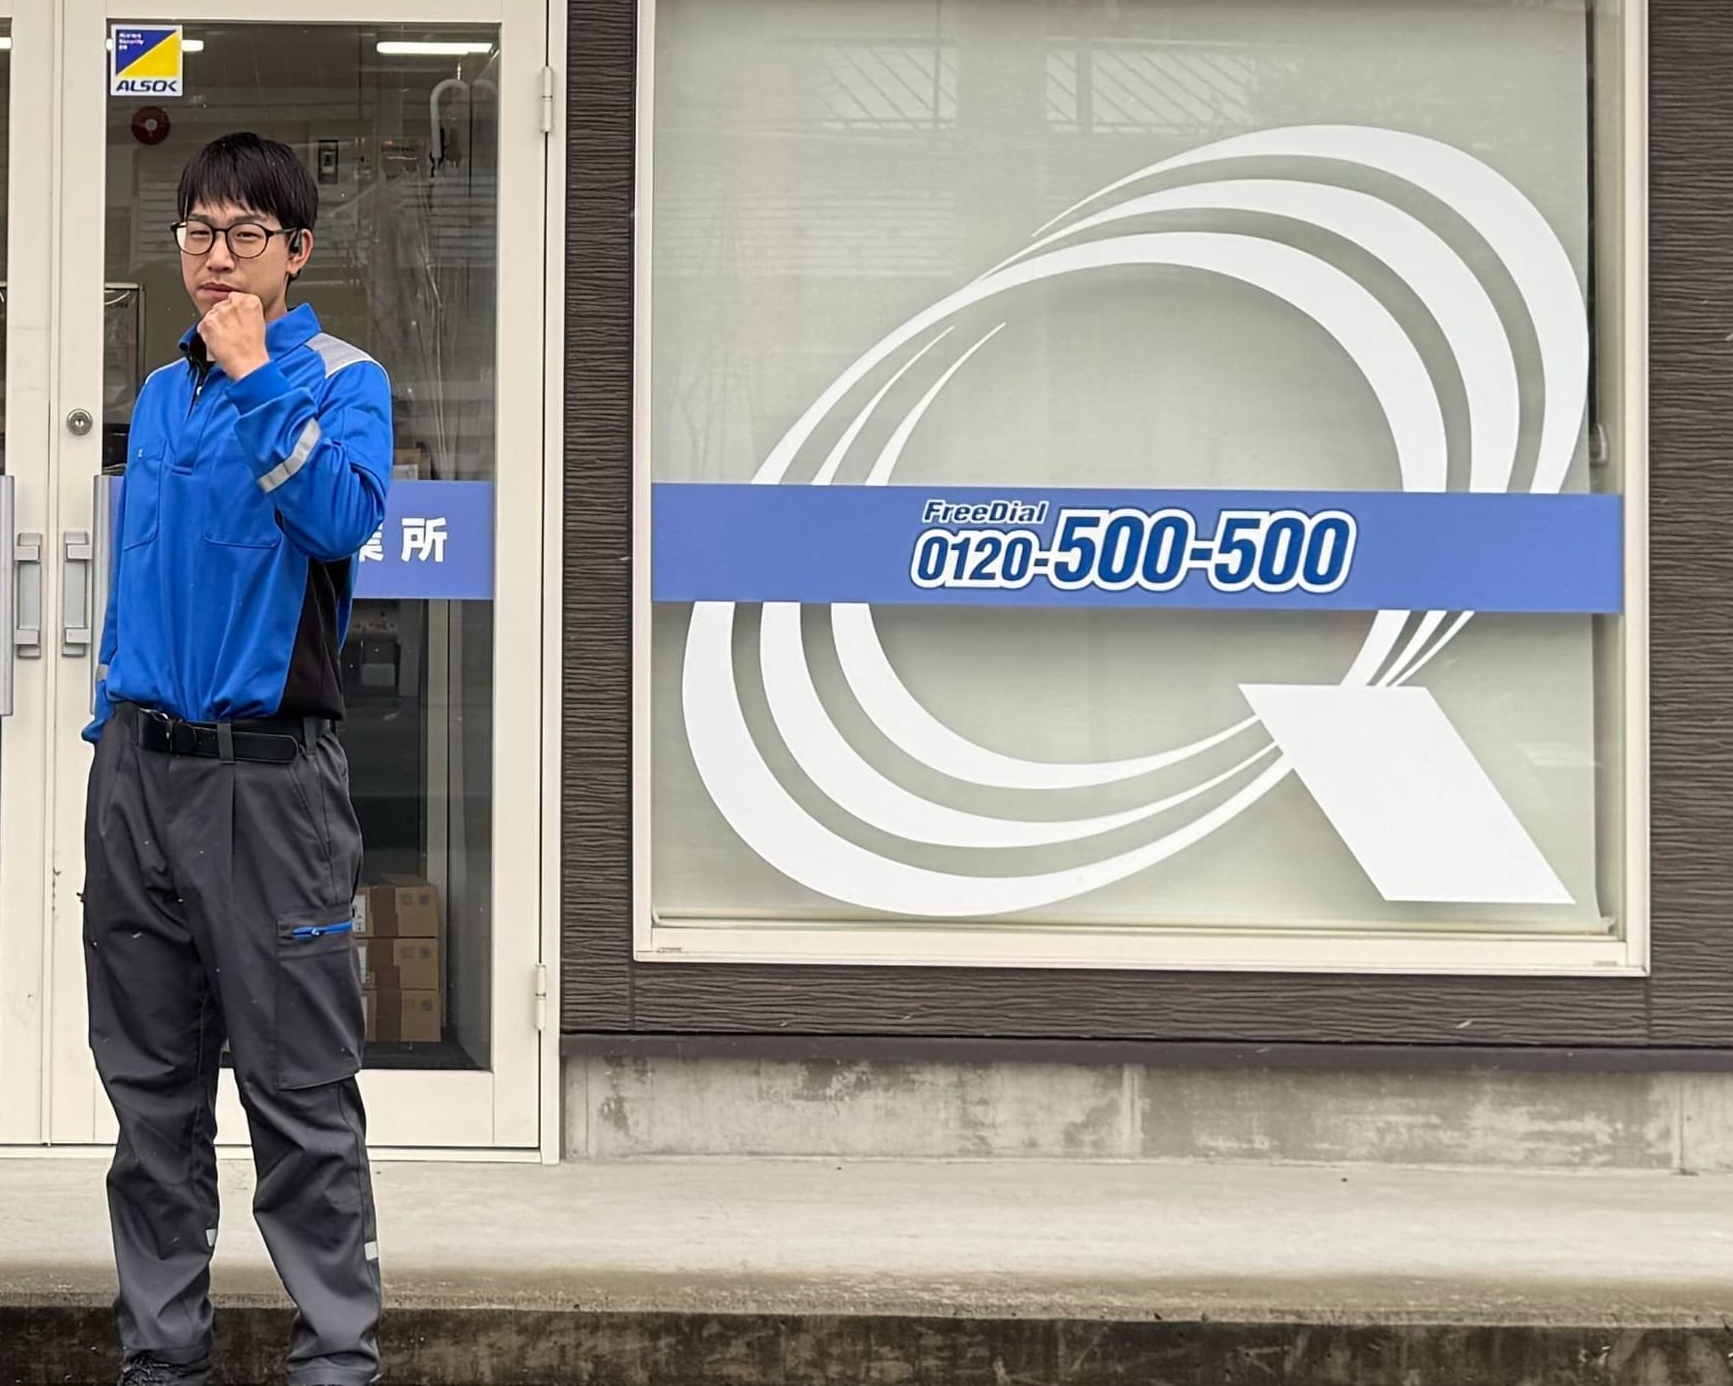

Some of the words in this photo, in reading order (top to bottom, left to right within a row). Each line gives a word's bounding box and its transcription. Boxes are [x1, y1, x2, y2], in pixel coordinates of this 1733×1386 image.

[116, 80, 177, 92] ALSOK
[922, 500, 1049, 524] FreeDial
[910, 508, 1358, 593] 0120-500-500
